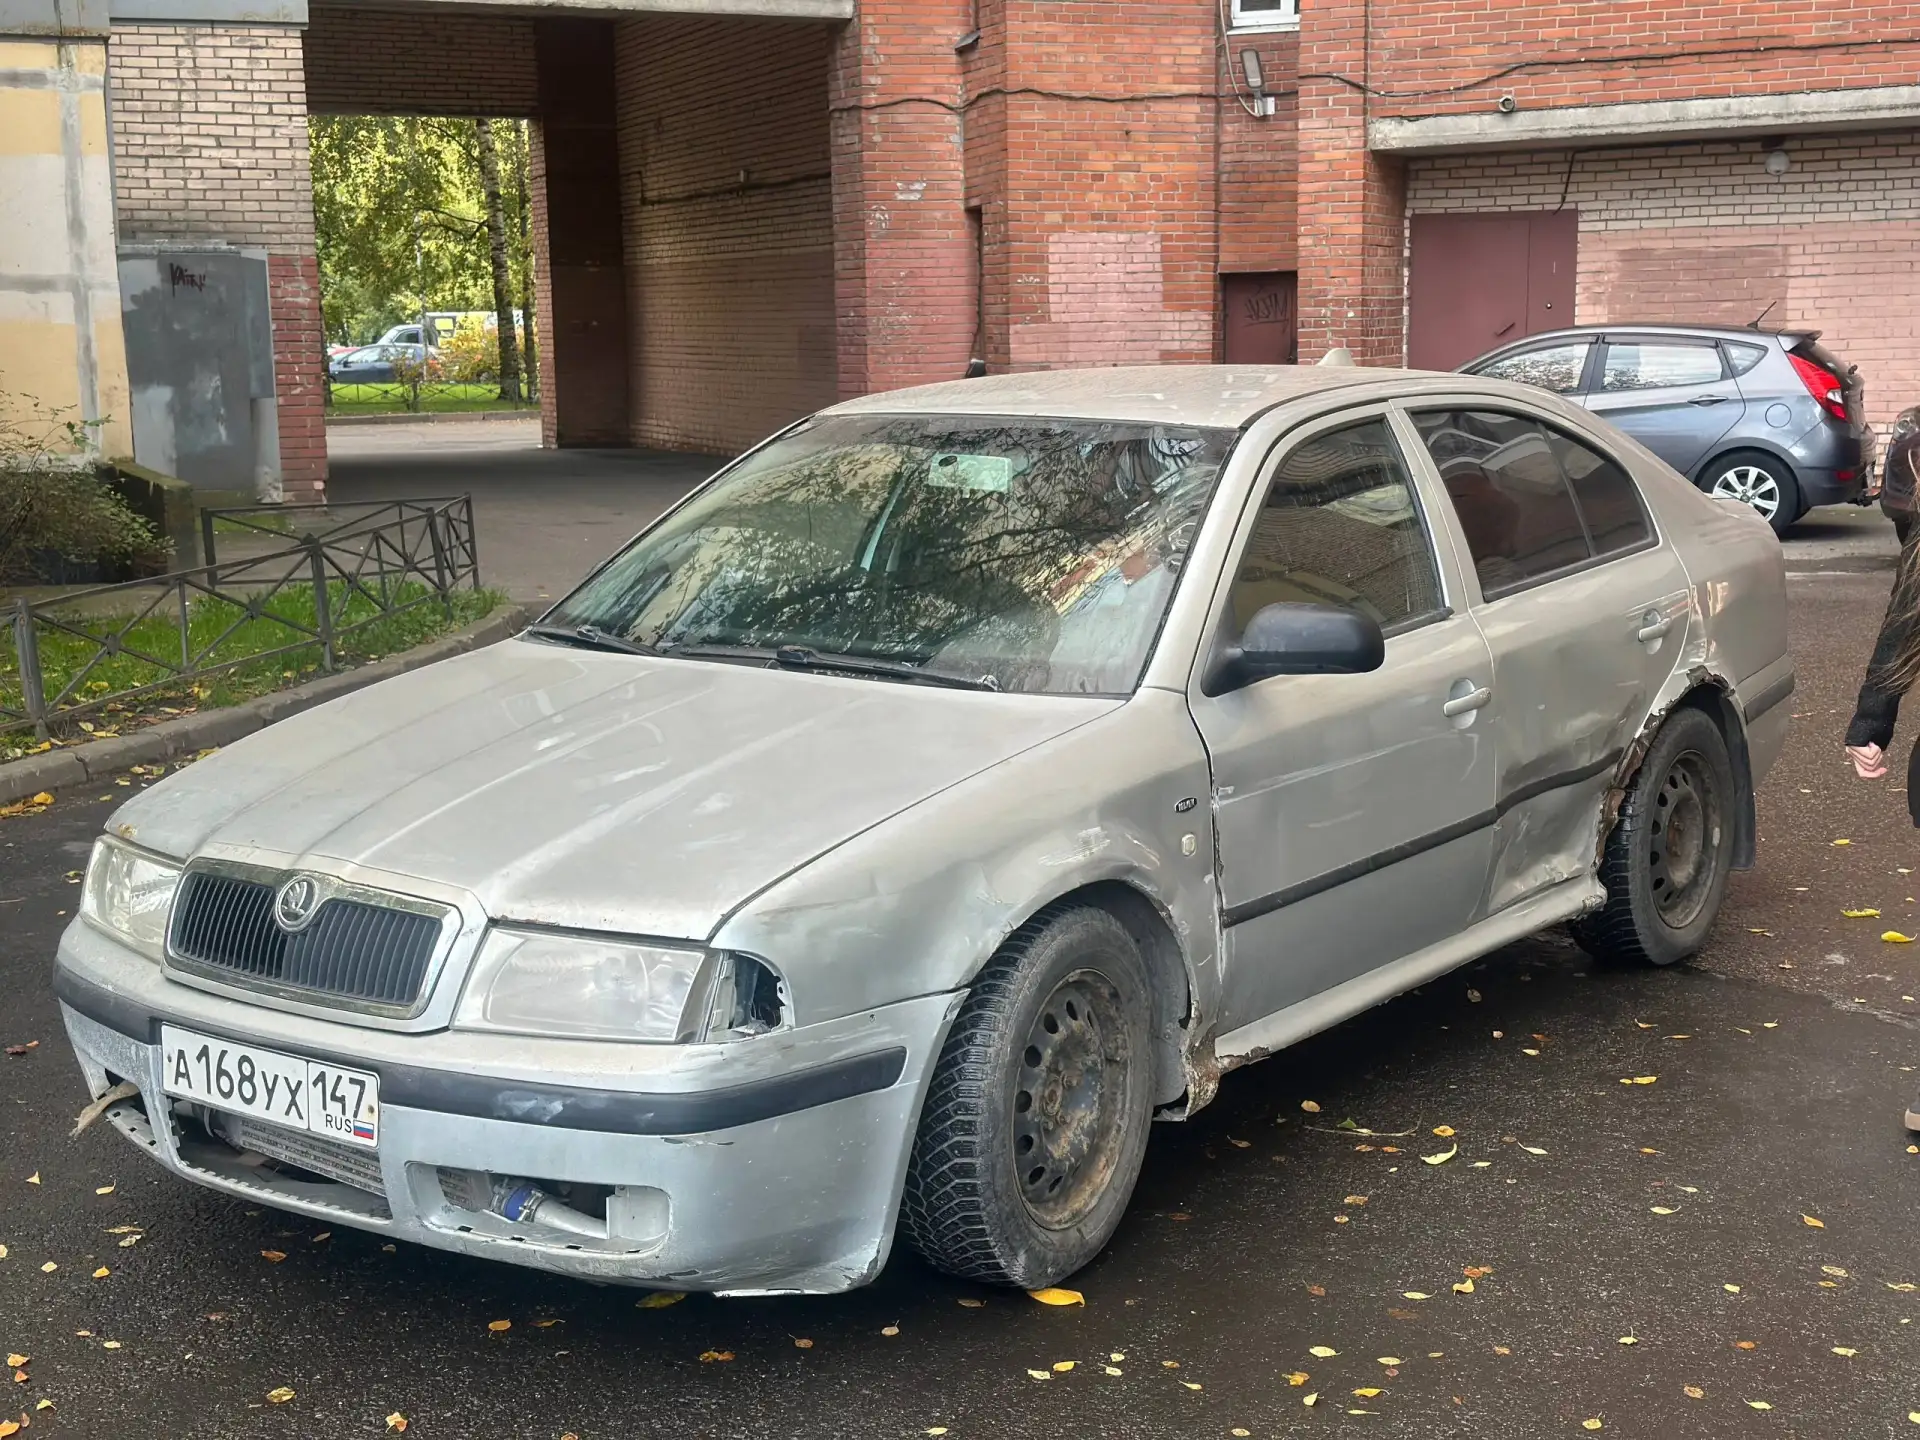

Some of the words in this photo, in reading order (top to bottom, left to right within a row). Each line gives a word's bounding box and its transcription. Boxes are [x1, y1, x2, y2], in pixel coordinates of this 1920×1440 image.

[174, 1045, 304, 1120] А168УХ
[312, 1071, 366, 1119] 147
[325, 1113, 352, 1134] RUS
